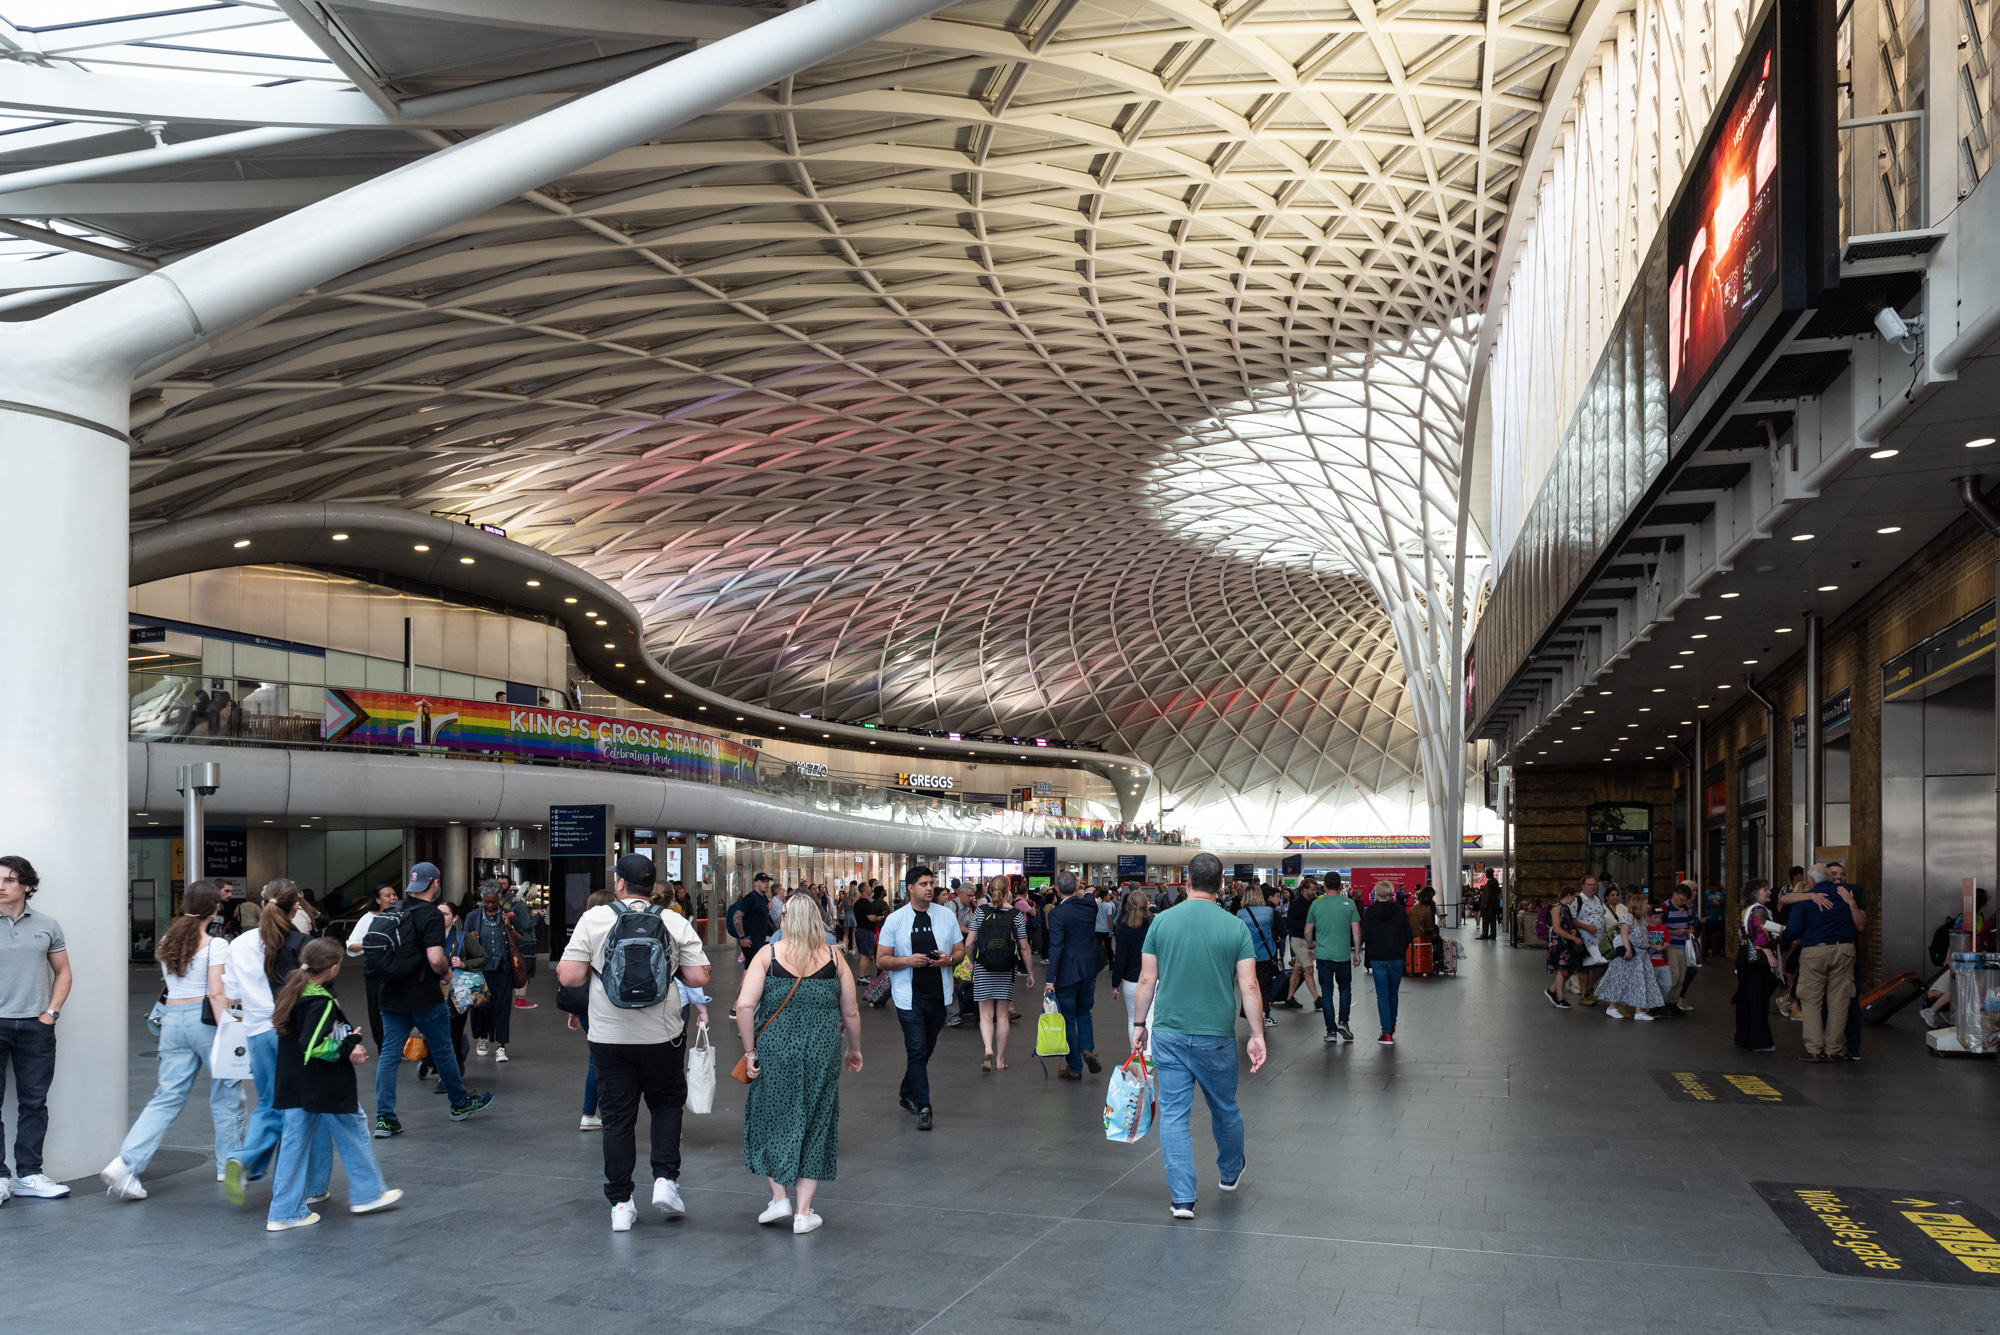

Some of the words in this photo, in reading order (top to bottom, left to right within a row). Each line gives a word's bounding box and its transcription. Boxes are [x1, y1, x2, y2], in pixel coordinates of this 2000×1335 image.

[509, 710, 591, 740] KING'S
[597, 721, 661, 749] CROSS
[665, 731, 719, 760] STATION
[603, 745, 650, 765] Celebrating
[652, 751, 672, 765] Pride
[796, 760, 829, 777] PREZZO
[909, 773, 954, 789] GREGGS
[1794, 1189, 1849, 1213] Wide
[1817, 1213, 1878, 1239] aisle
[1832, 1239, 1902, 1270] gate
